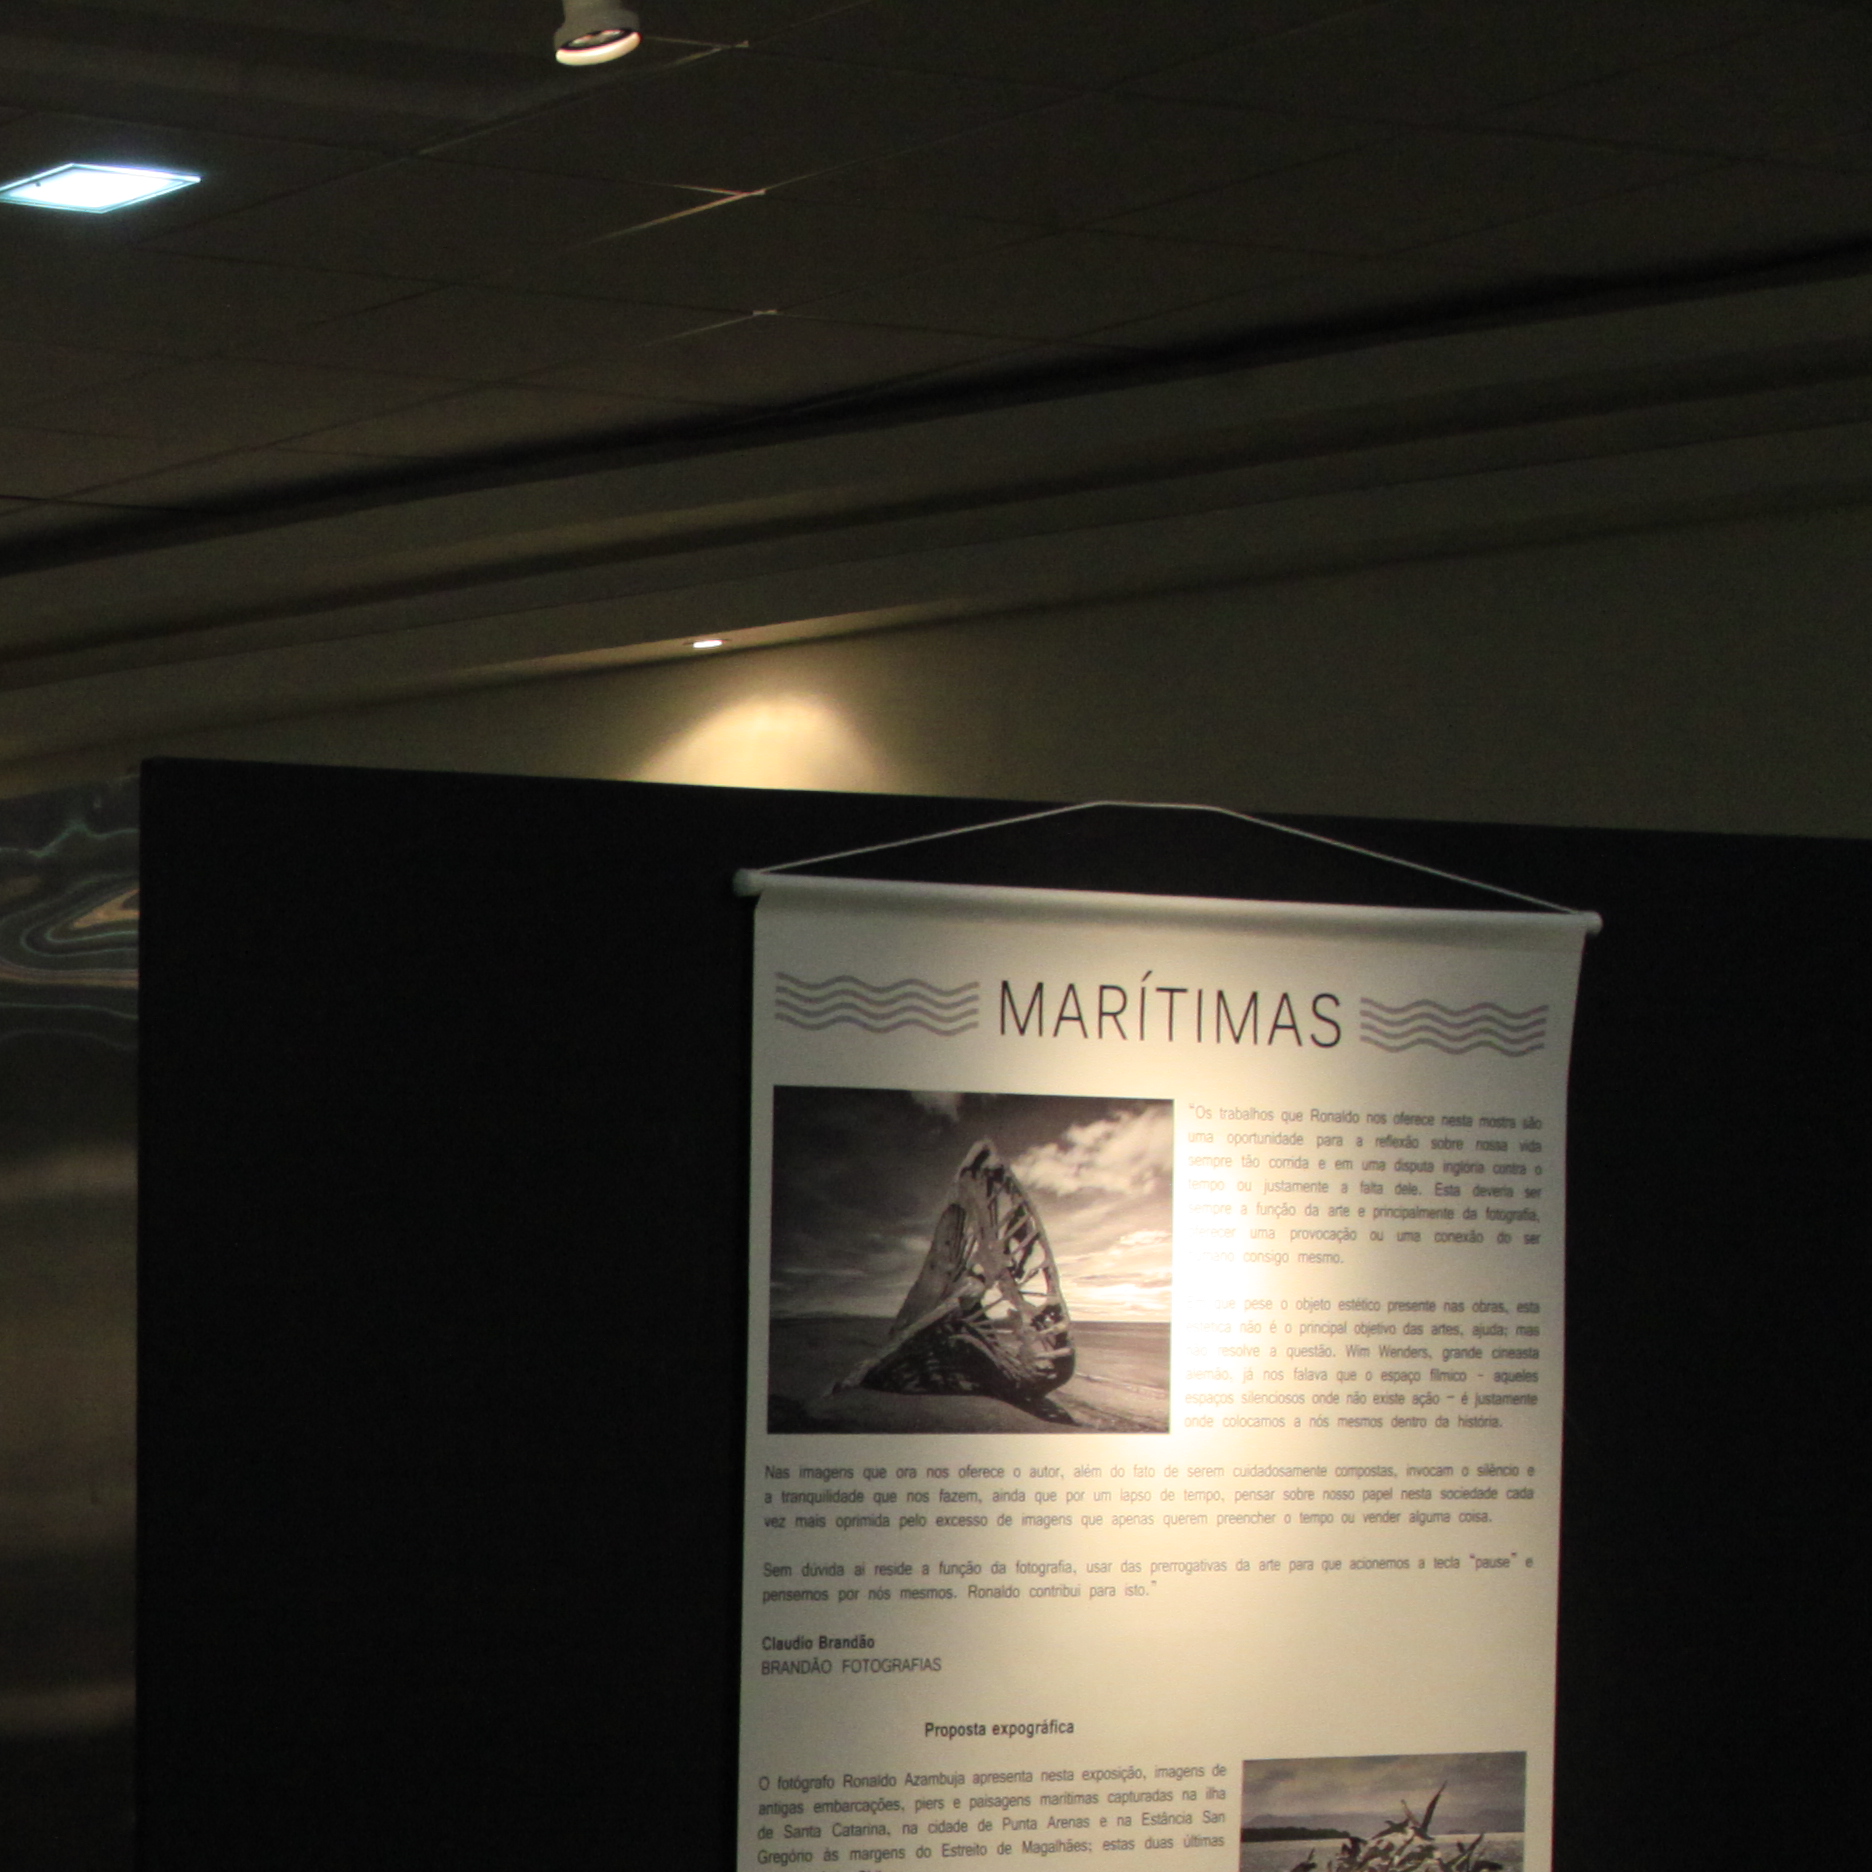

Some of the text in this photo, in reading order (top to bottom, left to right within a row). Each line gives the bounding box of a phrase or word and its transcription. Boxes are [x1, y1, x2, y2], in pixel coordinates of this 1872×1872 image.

[999, 969, 1343, 1049] MARÍTIMAS
[799, 1463, 854, 1482] imagens
[958, 1462, 1005, 1478] oferece
[1187, 1466, 1224, 1477] serem
[1233, 1461, 1327, 1476] cuidadosamente
[1406, 1461, 1453, 1476] invocam
[781, 1487, 864, 1507] tranquilidade
[992, 1486, 1025, 1502] ainda
[1120, 1486, 1151, 1505] lapso
[1235, 1490, 1274, 1504] pensar
[1284, 1485, 1315, 1500] sobre
[1323, 1489, 1355, 1500] nosso
[1363, 1484, 1393, 1504] papel
[1401, 1484, 1432, 1499] nesta
[1440, 1484, 1498, 1499] sociedade
[835, 1507, 1492, 1531] oprimida excesso imagens apenas querem preencher tempo vender alguma coisa.
[875, 1560, 913, 1575] reside
[939, 1559, 982, 1578] função
[1151, 1556, 1227, 1576] prerrogativas
[1350, 1554, 1410, 1569] acionemos
[1434, 1553, 1460, 1568] tecla
[762, 1581, 1081, 1605] pensemos mesmos. Ronaldo contribui
[762, 1634, 875, 1649] Claudio Brandão
[761, 1655, 941, 1673] BRANDÃO FOTOGRAFIAS
[925, 1718, 1074, 1739] Proposta expográfica
[843, 1771, 897, 1787] Ronaldo
[905, 1769, 965, 1788] Azambuja
[973, 1767, 1033, 1787] apresenta
[1041, 1766, 1074, 1782] nesta
[1155, 1763, 1205, 1781] imagens
[758, 1799, 804, 1818] antigas
[915, 1794, 944, 1814] piers
[969, 1792, 1031, 1812] paisagens
[1107, 1786, 1173, 1807] capturadas
[784, 1822, 822, 1838] Santa
[928, 1817, 968, 1833] cidade
[1002, 1814, 1037, 1830] Punta
[1047, 1813, 1090, 1829] Arenas
[849, 1847, 905, 1863] margens
[942, 1840, 987, 1856] Estreito
[1102, 1835, 1135, 1851] estas
